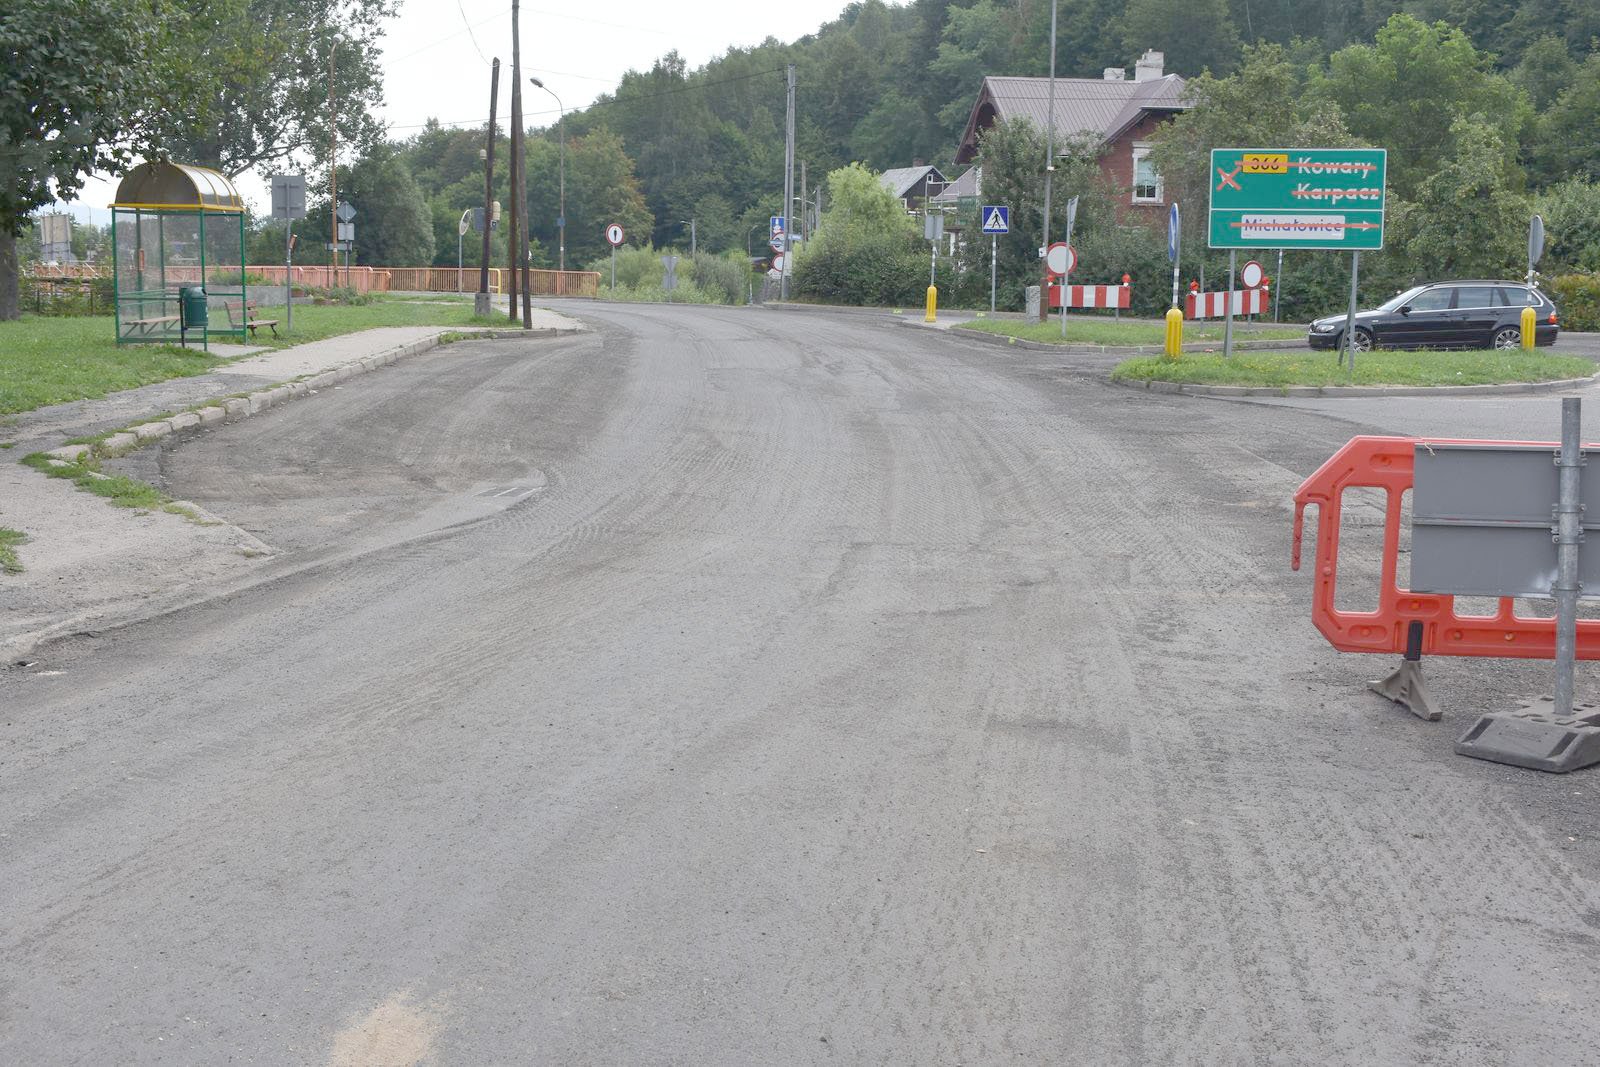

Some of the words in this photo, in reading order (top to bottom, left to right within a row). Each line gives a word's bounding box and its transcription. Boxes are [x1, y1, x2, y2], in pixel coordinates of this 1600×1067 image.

[1251, 158, 1280, 171] 366
[1298, 157, 1371, 178] Kowary
[1297, 183, 1379, 204] Karpacz
